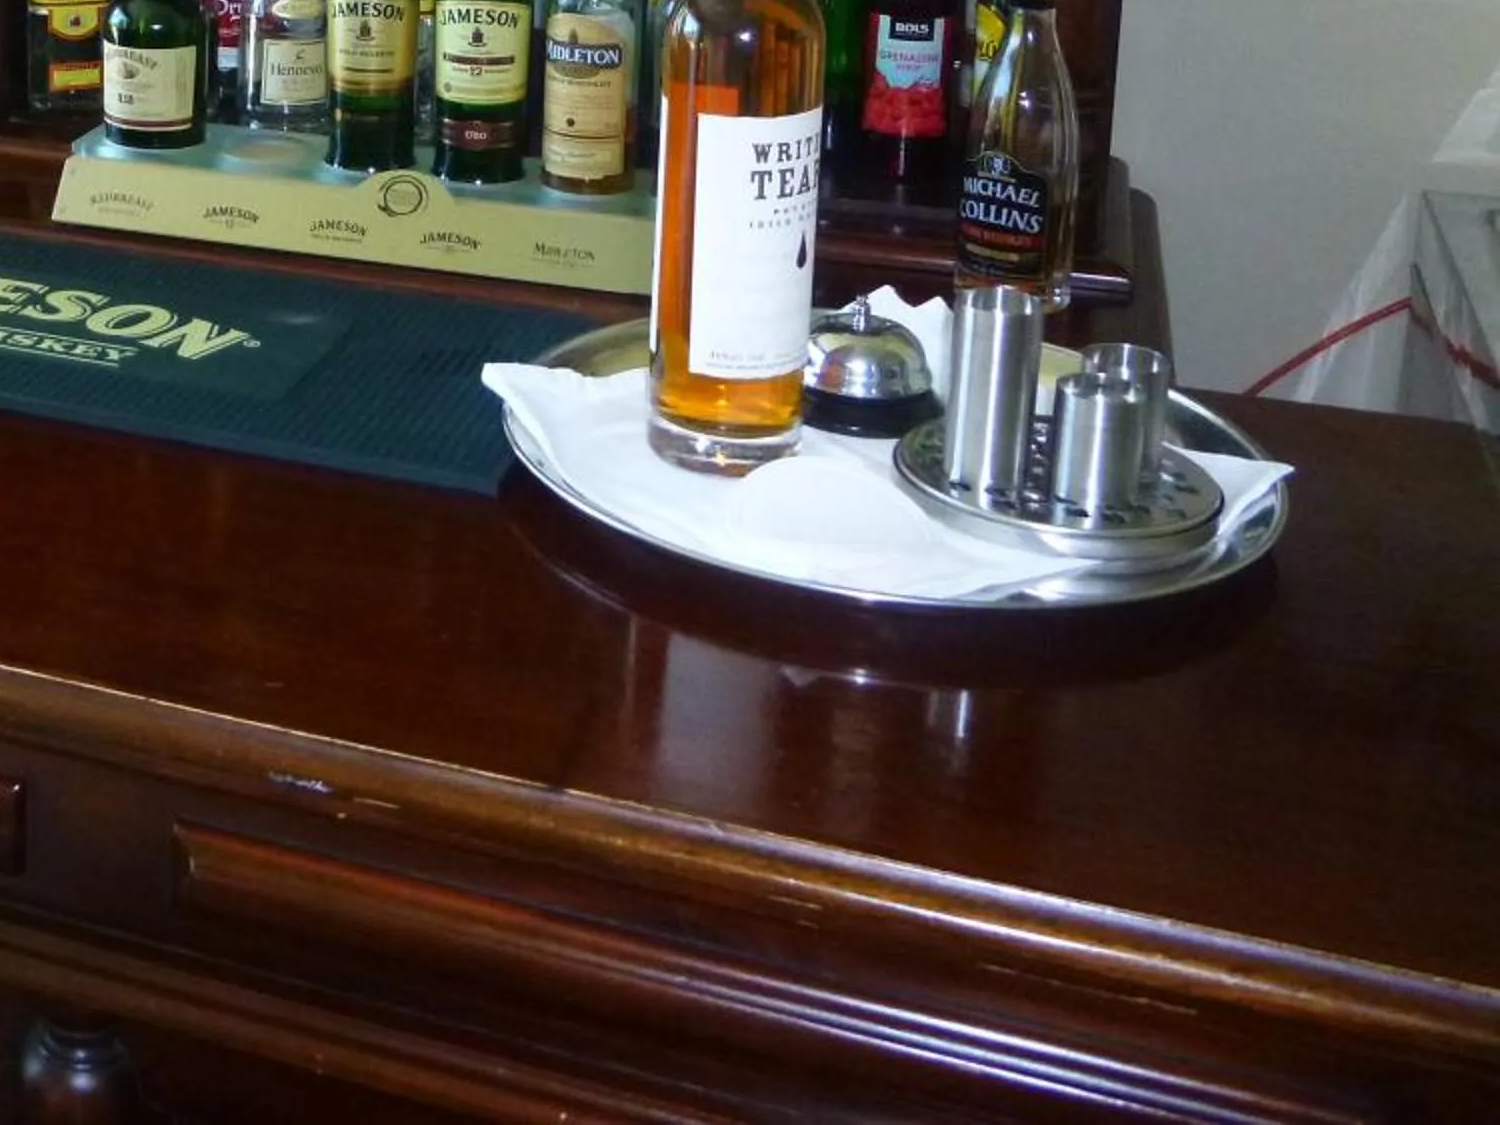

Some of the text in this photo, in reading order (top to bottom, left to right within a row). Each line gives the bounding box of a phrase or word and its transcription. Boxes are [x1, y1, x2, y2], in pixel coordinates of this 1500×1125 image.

[332, 2, 405, 22] JAMESON
[440, 8, 520, 29] JAMESON
[963, 177, 1041, 208] MICHAEL
[202, 206, 260, 225] JAMESON
[959, 199, 1044, 235] COLLINS
[309, 218, 369, 238] JAMESON
[420, 231, 482, 251] JAMESON
